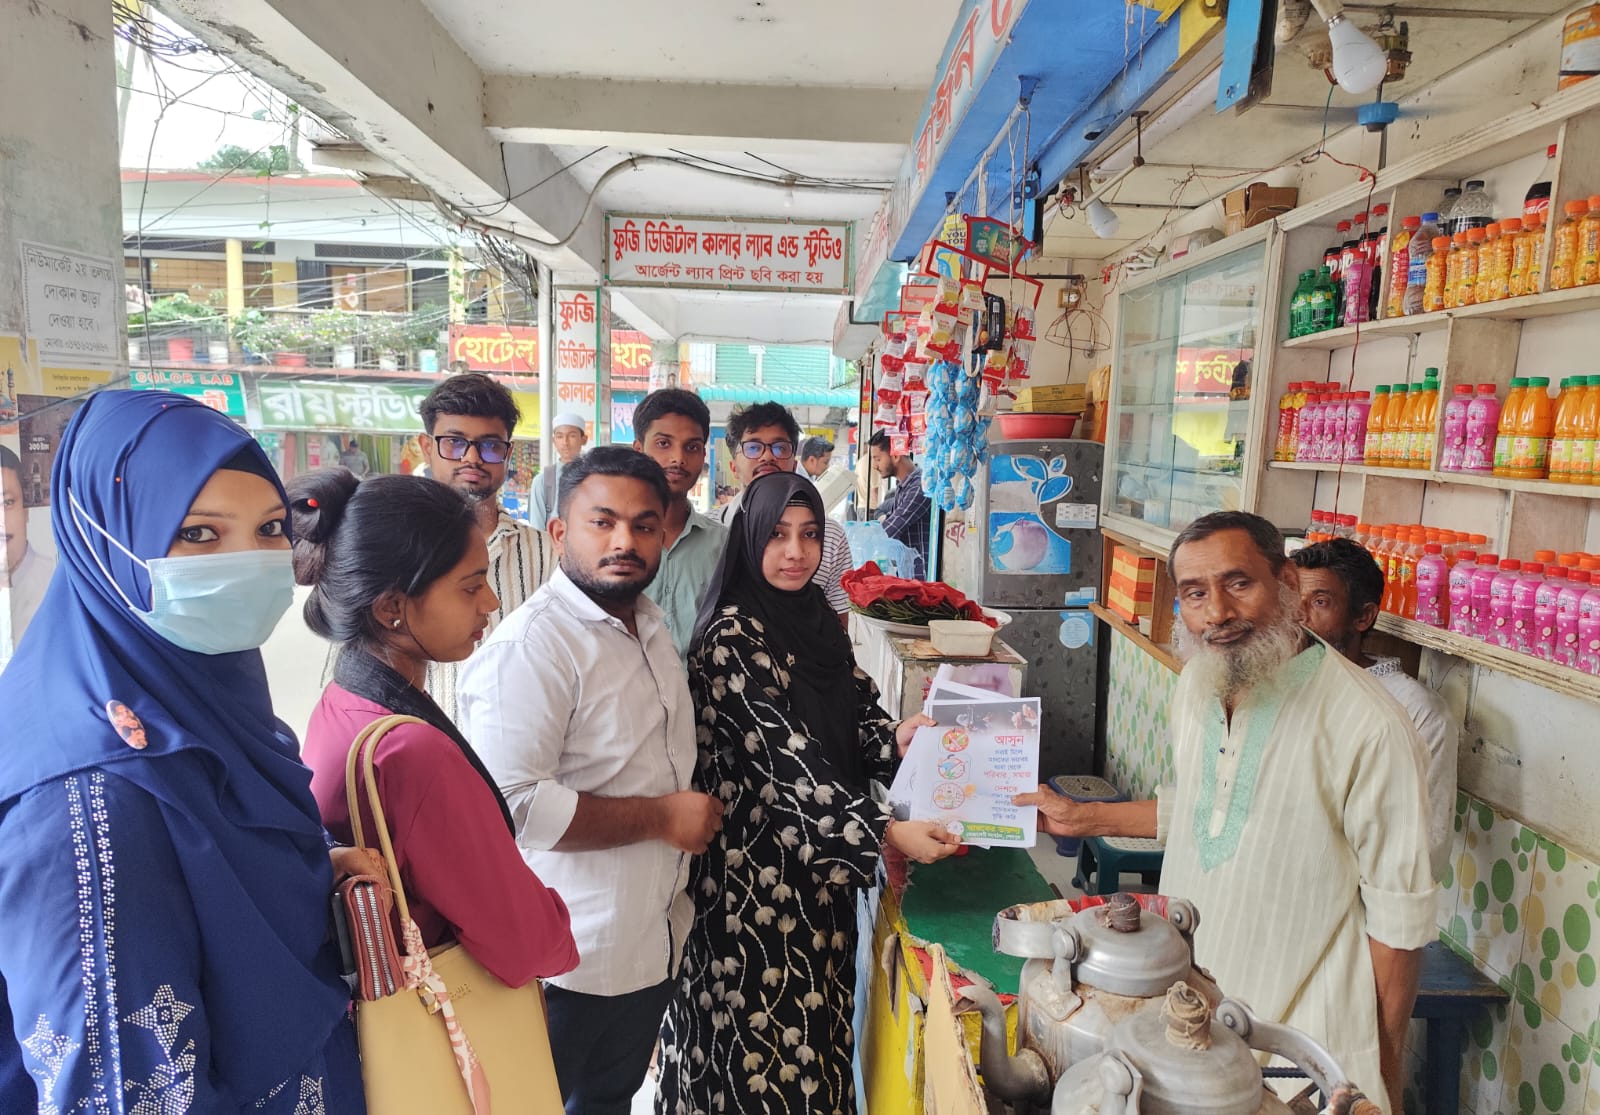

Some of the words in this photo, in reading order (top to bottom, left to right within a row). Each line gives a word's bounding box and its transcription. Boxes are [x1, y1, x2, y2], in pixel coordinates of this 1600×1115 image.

[613, 219, 640, 261] ফুজি
[644, 220, 698, 255] ডিজিটাল
[702, 231, 742, 260] কালার
[746, 234, 773, 261] ল্যাব
[777, 236, 799, 258] এন্ড
[803, 227, 842, 267] স্টুডিও
[635, 262, 681, 278] আর্জেন্ট
[685, 267, 714, 280] ল্যাব
[719, 264, 745, 280] প্রিন্ট
[750, 266, 772, 282] ছবি
[776, 270, 801, 284] করা
[805, 271, 824, 285] হয়
[44, 284, 77, 301] দোকান
[559, 293, 596, 331] ফুজি
[455, 333, 537, 365] হোটেল
[558, 340, 596, 370] ডিজিটাল
[200, 373, 233, 386] LAB
[558, 382, 596, 404] কালার
[994, 735, 1024, 747] আসুন
